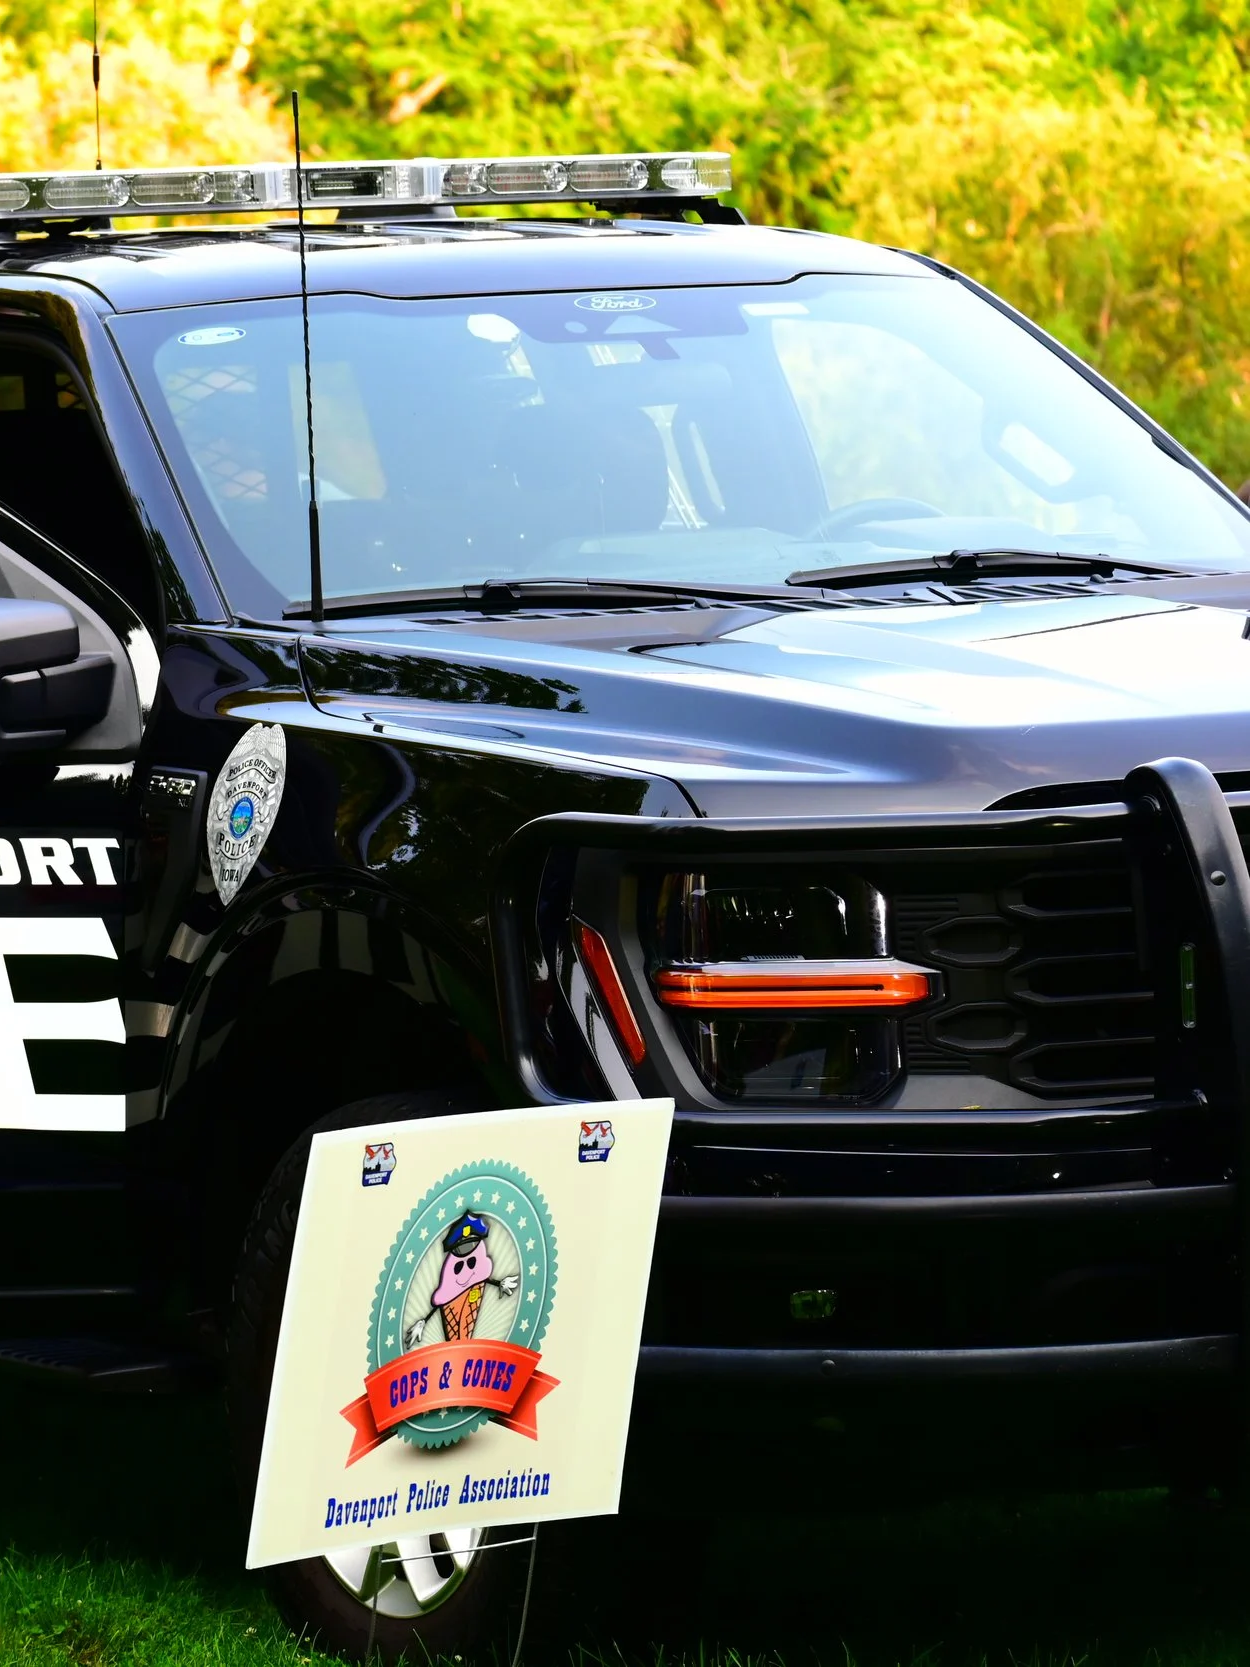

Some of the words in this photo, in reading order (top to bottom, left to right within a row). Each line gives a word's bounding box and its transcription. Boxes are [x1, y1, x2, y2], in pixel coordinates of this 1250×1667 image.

[591, 296, 643, 309] Ford
[229, 758, 253, 776] POLICE
[254, 758, 277, 779] OFFICER
[227, 781, 267, 799] DAVENPORT
[218, 832, 257, 857] POLICE
[221, 868, 239, 882] IOWA
[390, 1366, 429, 1409] COPS
[439, 1361, 452, 1390] &
[462, 1359, 517, 1392] CONES
[325, 1487, 398, 1529] Davenport
[406, 1479, 450, 1513] Police
[459, 1467, 551, 1505] Association
